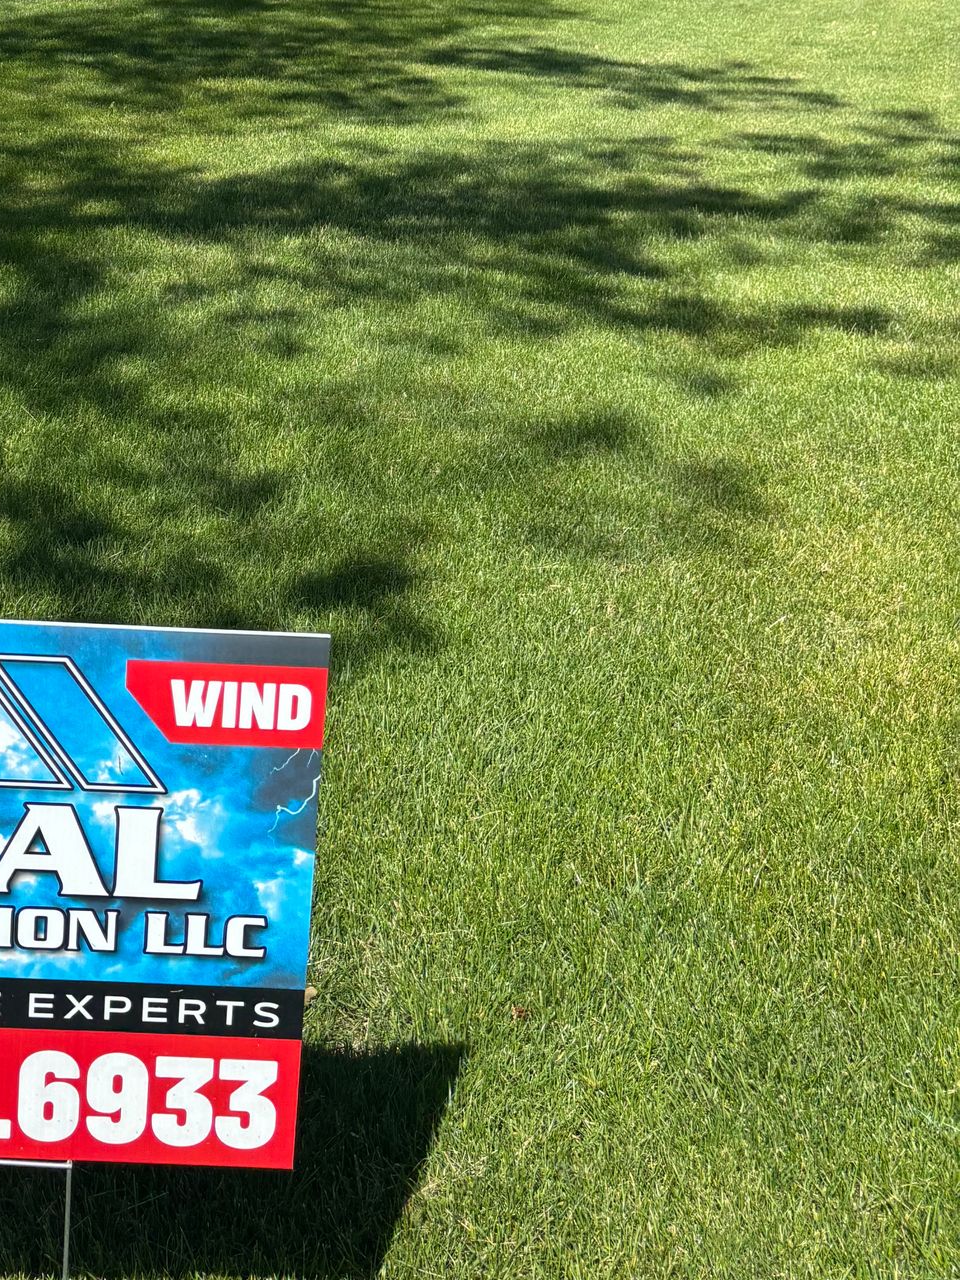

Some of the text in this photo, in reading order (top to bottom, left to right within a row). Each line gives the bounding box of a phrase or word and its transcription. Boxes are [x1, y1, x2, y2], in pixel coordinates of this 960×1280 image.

[170, 677, 313, 732] WIND
[143, 910, 268, 959] LLC
[28, 991, 281, 1029] EXPERTS
